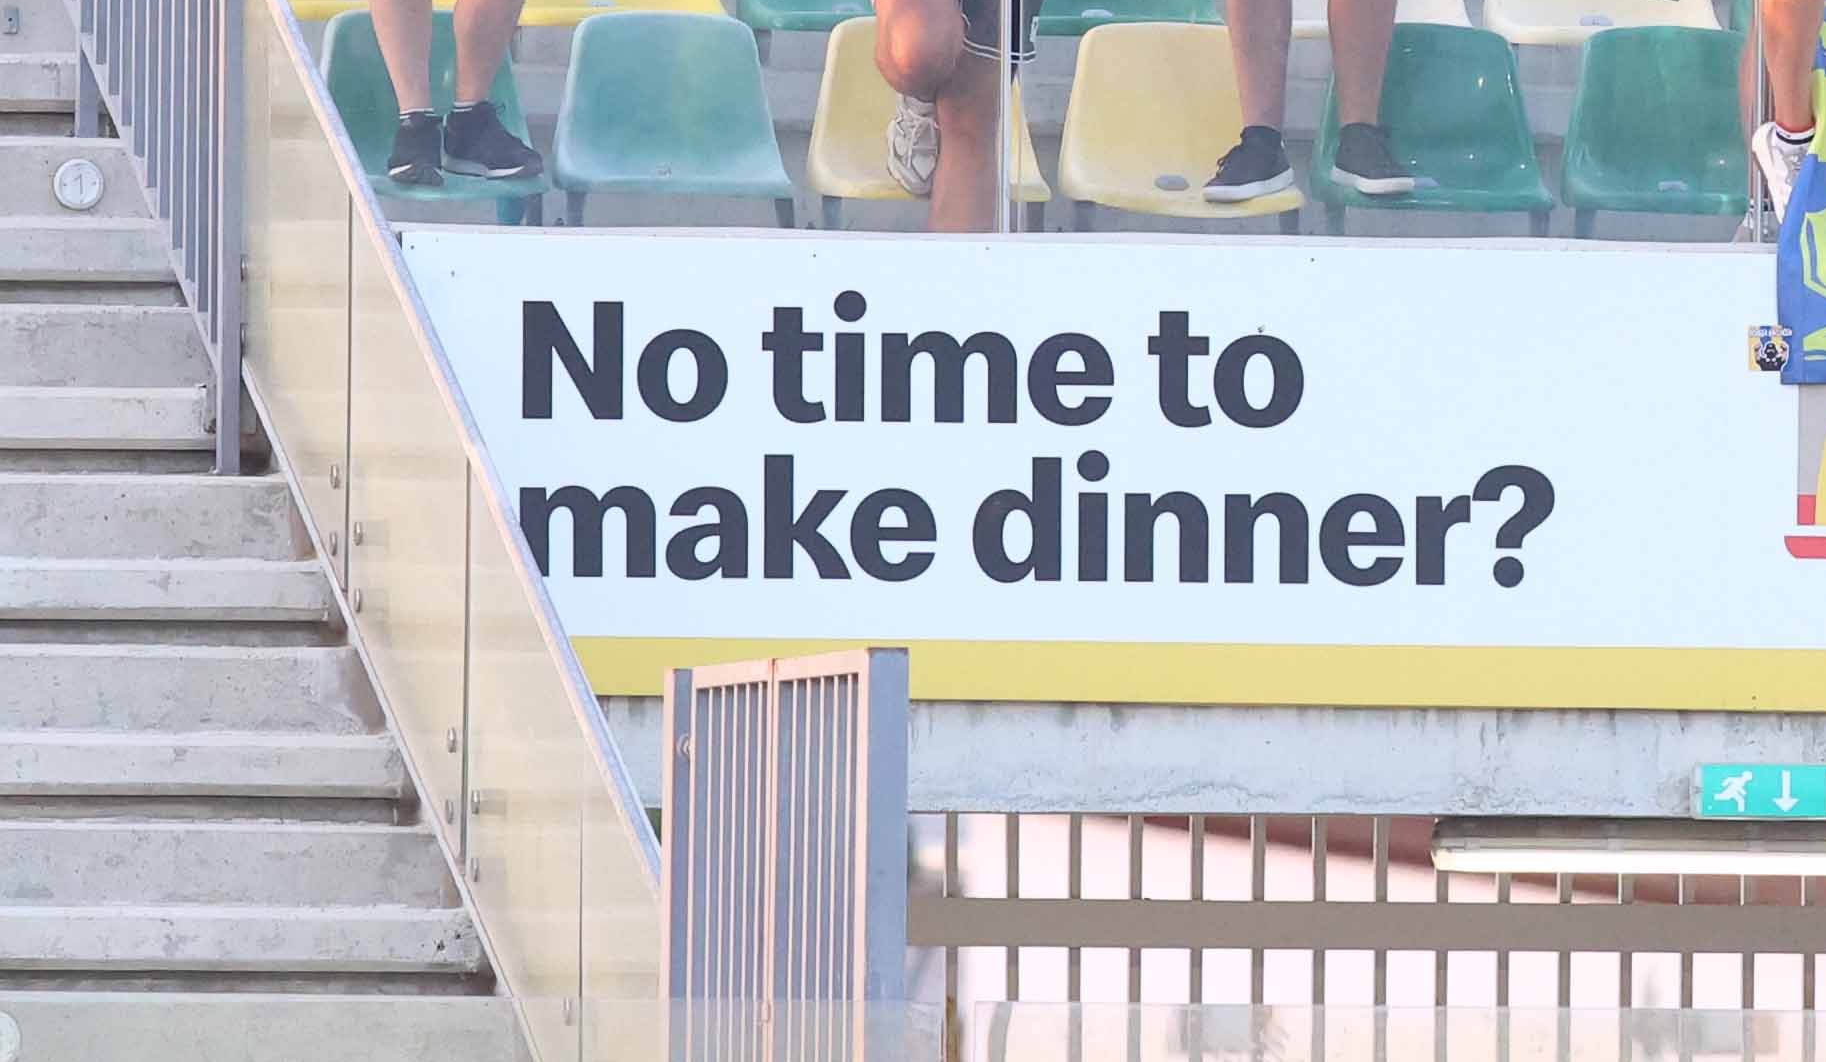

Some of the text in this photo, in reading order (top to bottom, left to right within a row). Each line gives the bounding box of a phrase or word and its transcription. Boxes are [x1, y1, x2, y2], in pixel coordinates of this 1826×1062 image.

[72, 173, 84, 195] 1
[522, 290, 1305, 429] No time to
[519, 449, 1555, 589] make dinner?
